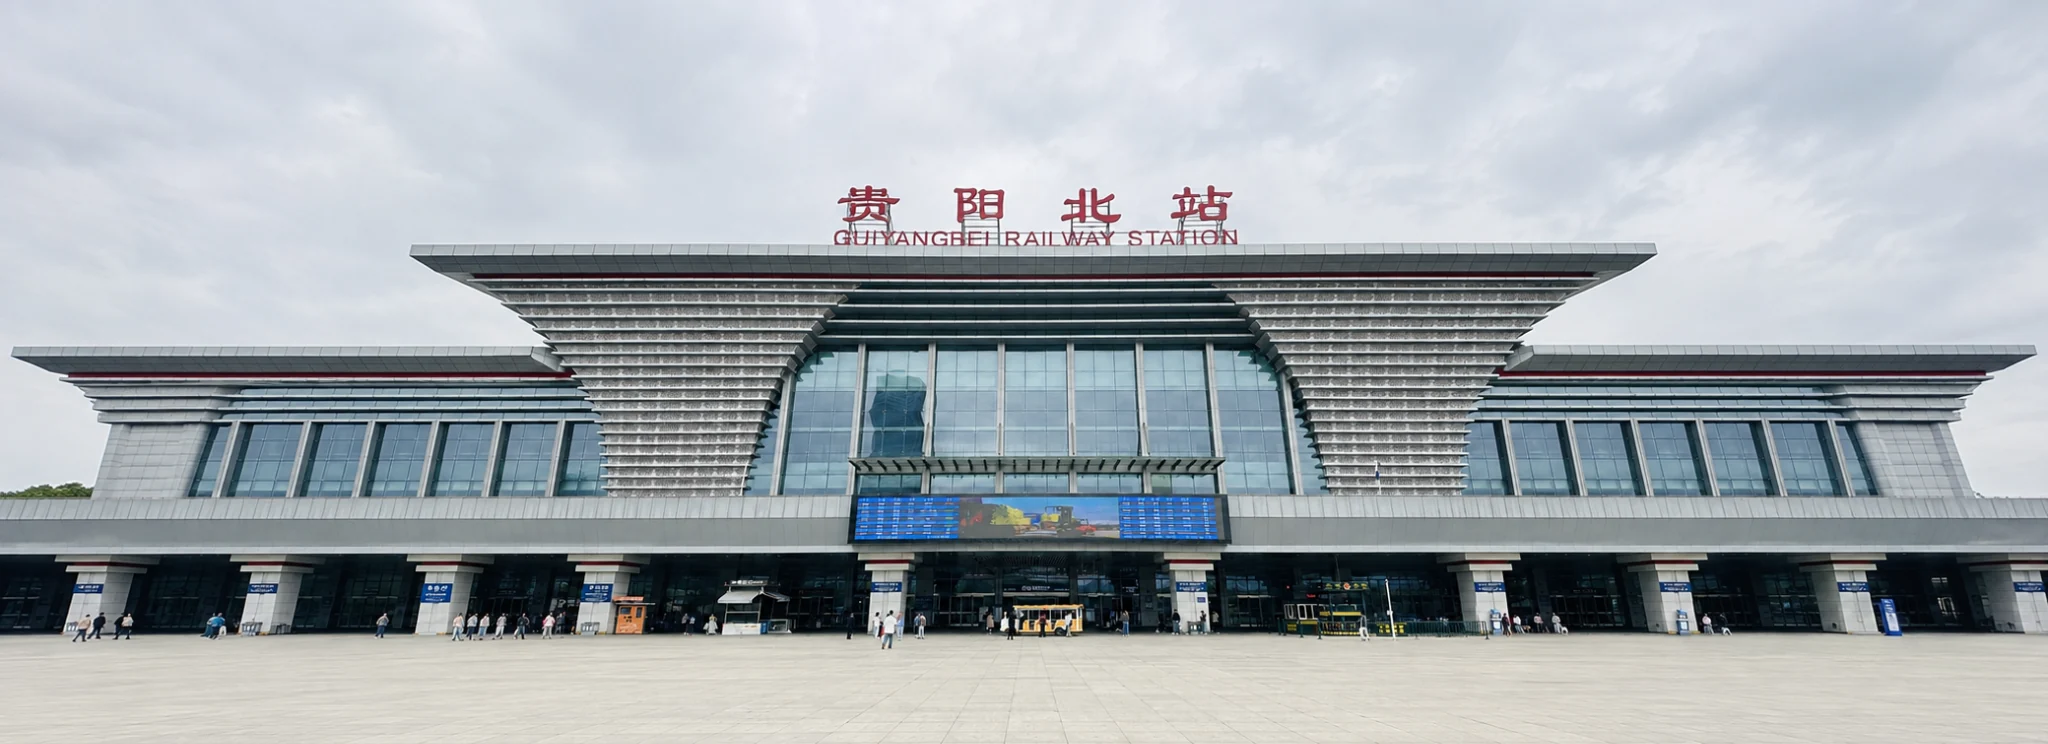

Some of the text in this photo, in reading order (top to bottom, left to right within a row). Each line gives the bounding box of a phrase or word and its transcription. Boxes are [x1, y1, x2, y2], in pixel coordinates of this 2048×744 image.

[838, 185, 1233, 223] 贵阳北站
[833, 229, 1238, 246] GUIYANGBEI RAILWAY STATION
